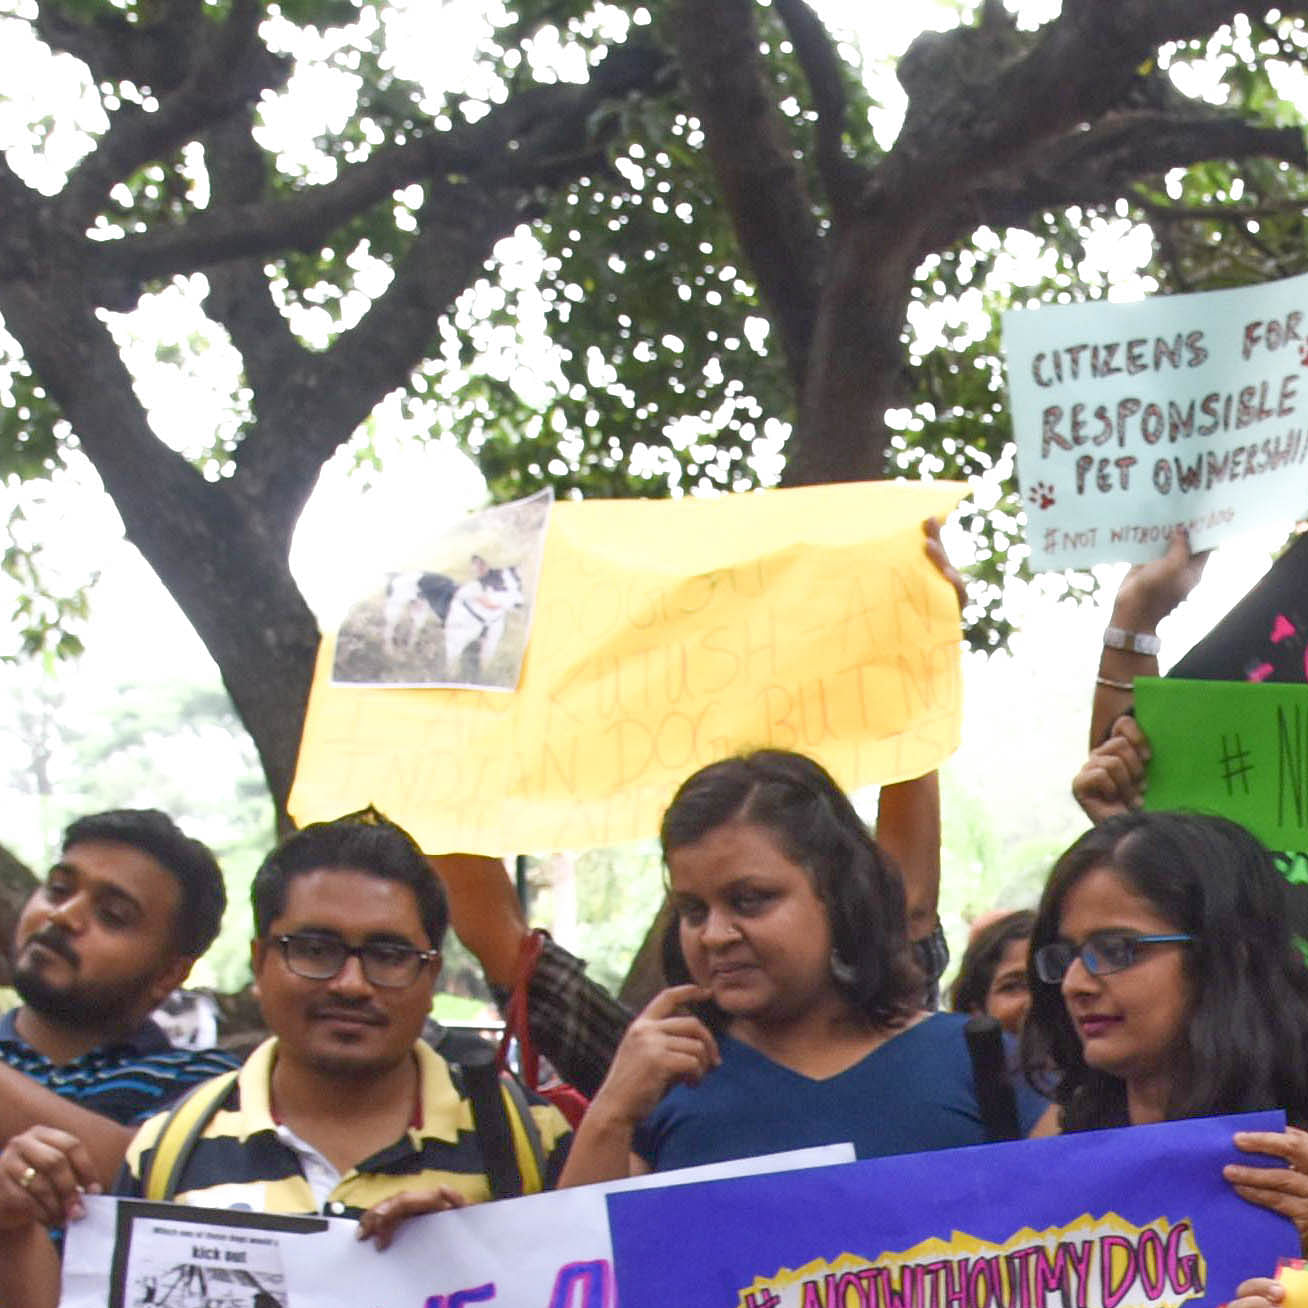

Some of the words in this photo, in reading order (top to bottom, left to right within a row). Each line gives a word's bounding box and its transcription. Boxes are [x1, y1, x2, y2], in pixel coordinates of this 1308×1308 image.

[1032, 330, 1209, 388] CITIZENS
[1243, 311, 1304, 361] FOR
[1041, 375, 1301, 459] RESPONSIBLE
[1075, 455, 1138, 495] PET
[191, 1245, 220, 1261] kick
